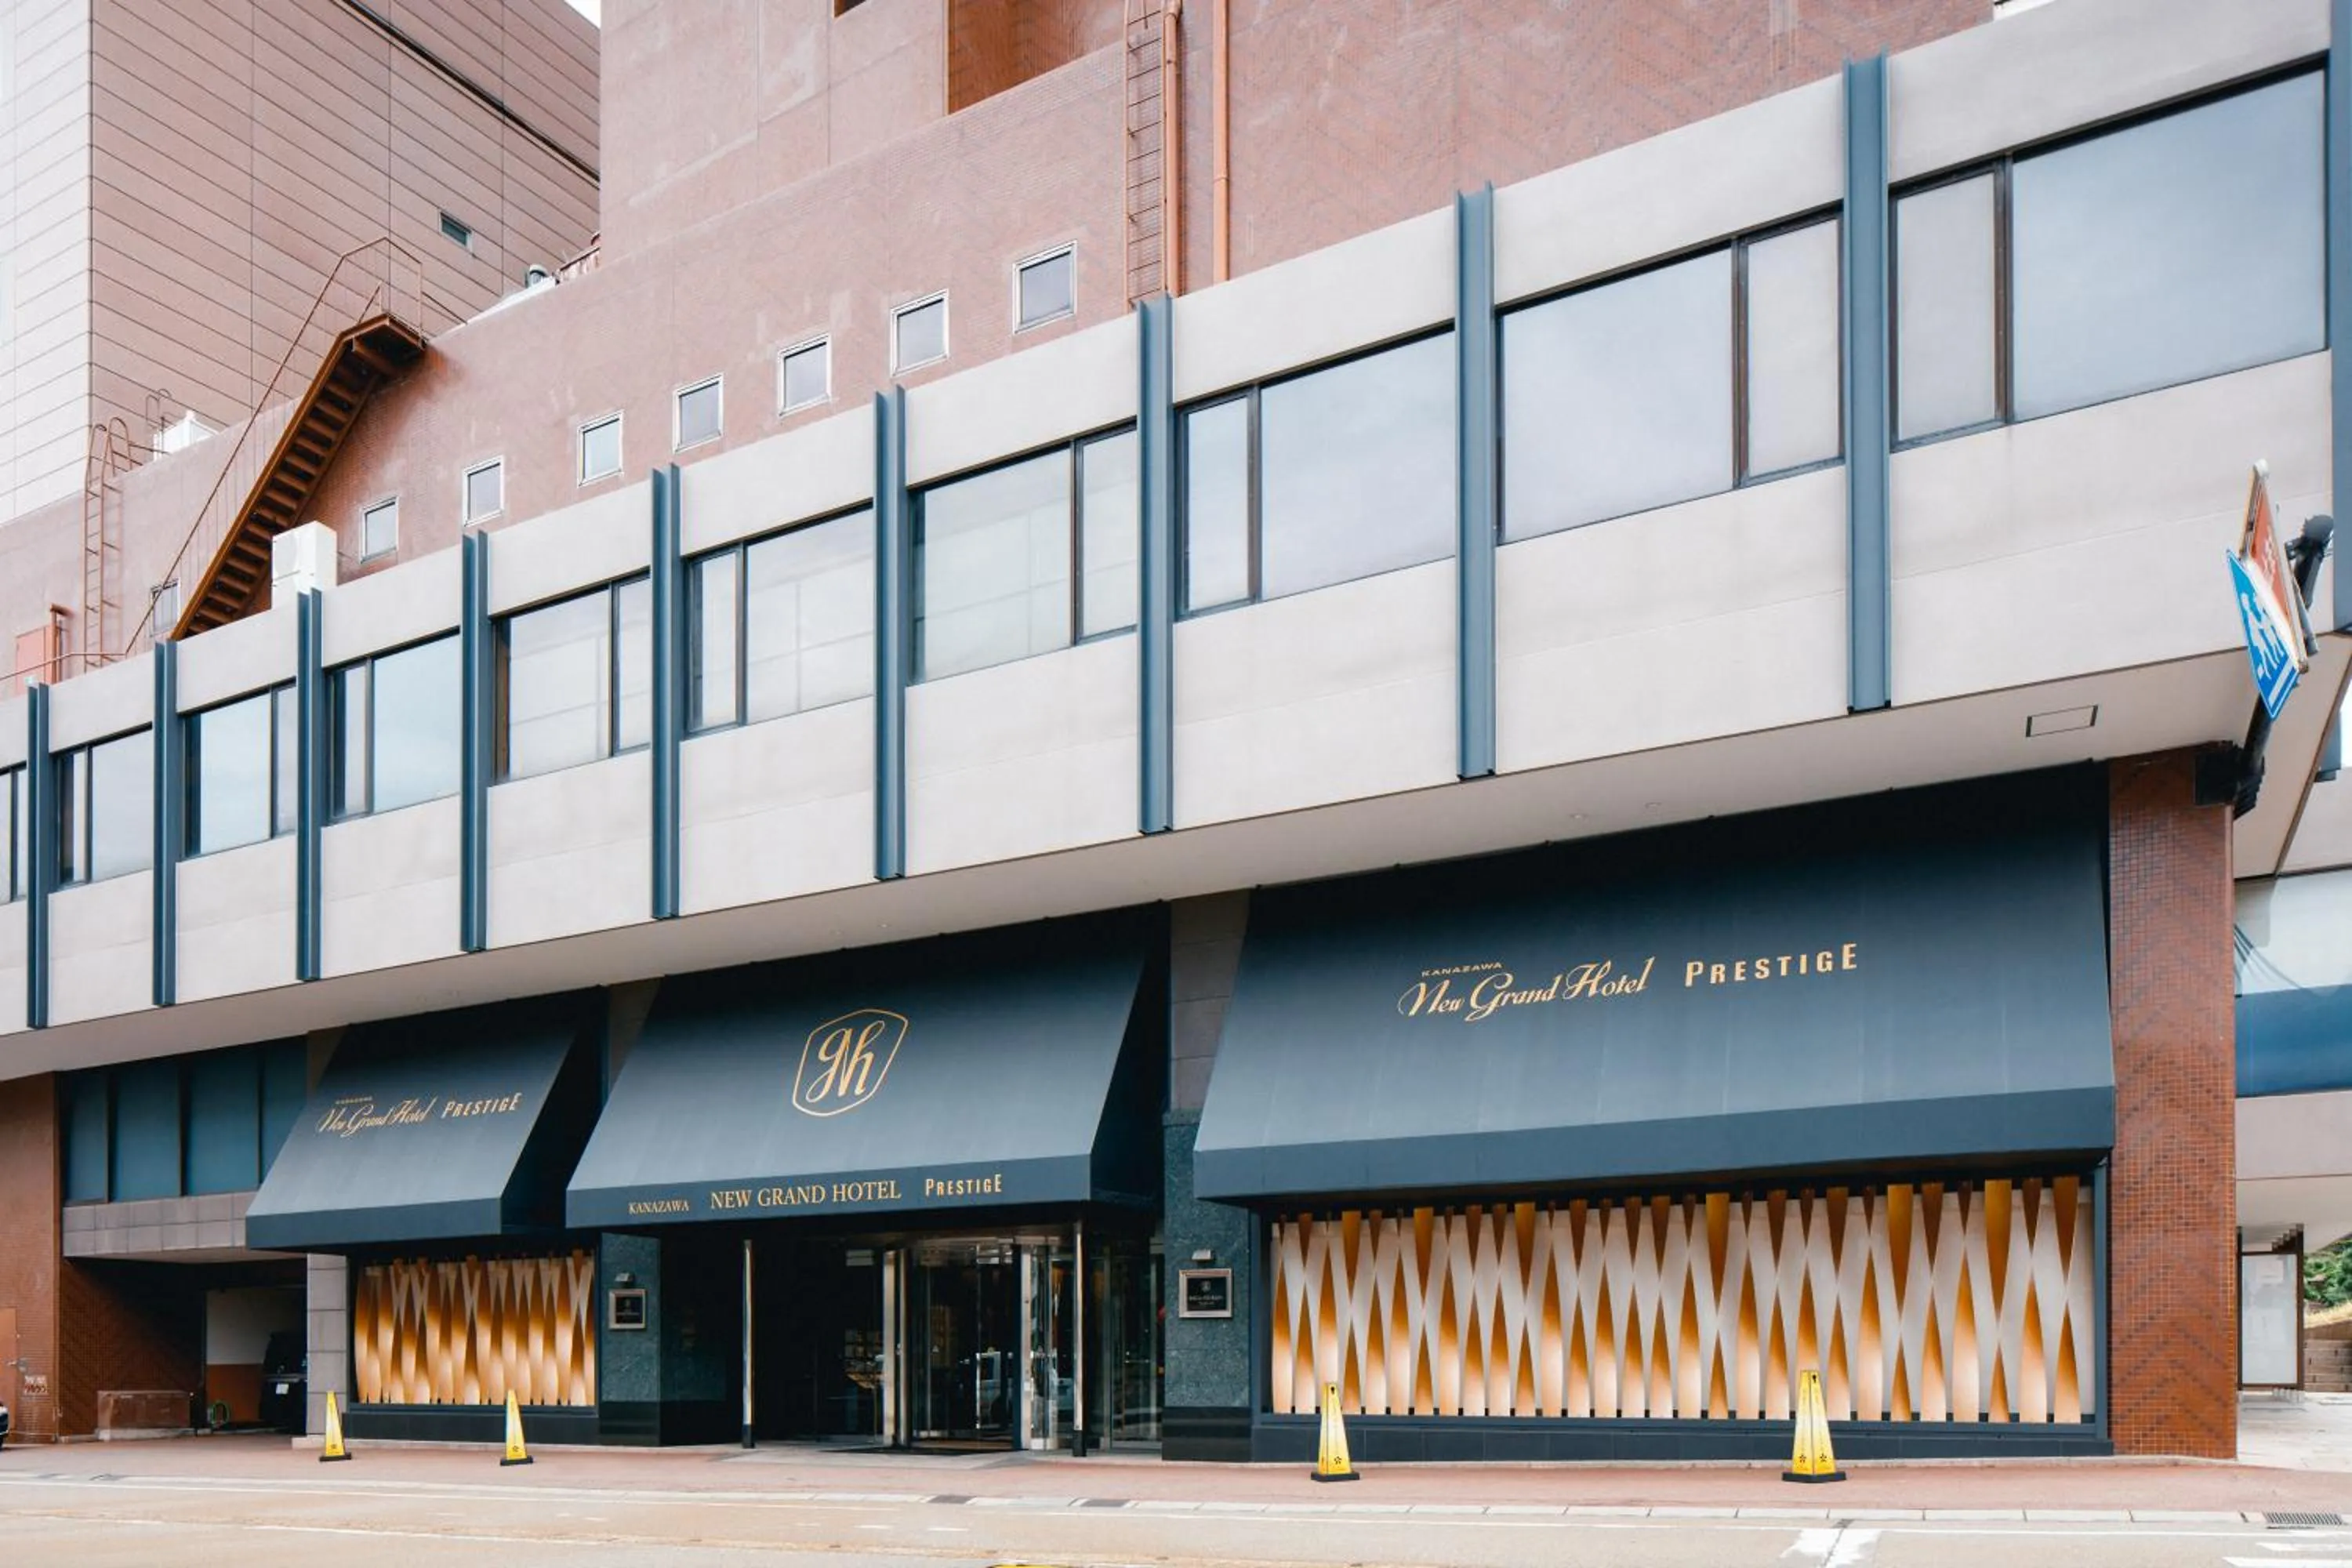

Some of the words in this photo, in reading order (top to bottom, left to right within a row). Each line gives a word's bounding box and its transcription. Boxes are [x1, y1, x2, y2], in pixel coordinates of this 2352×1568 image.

[1397, 981, 1465, 1017] New
[1464, 972, 1564, 1022] Grand
[1563, 955, 1656, 1000] Hotel
[1684, 942, 1858, 988] PRESTIGE
[1421, 961, 1503, 978] KANAZAWA
[339, 1104, 393, 1138] Grand
[390, 1095, 438, 1125] Hotel
[441, 1092, 523, 1120] PRESTIGE
[627, 1200, 691, 1216] KANAZAWA
[710, 1189, 753, 1210] NEW
[757, 1185, 826, 1208] GRAND
[832, 1179, 902, 1203] HOTEL
